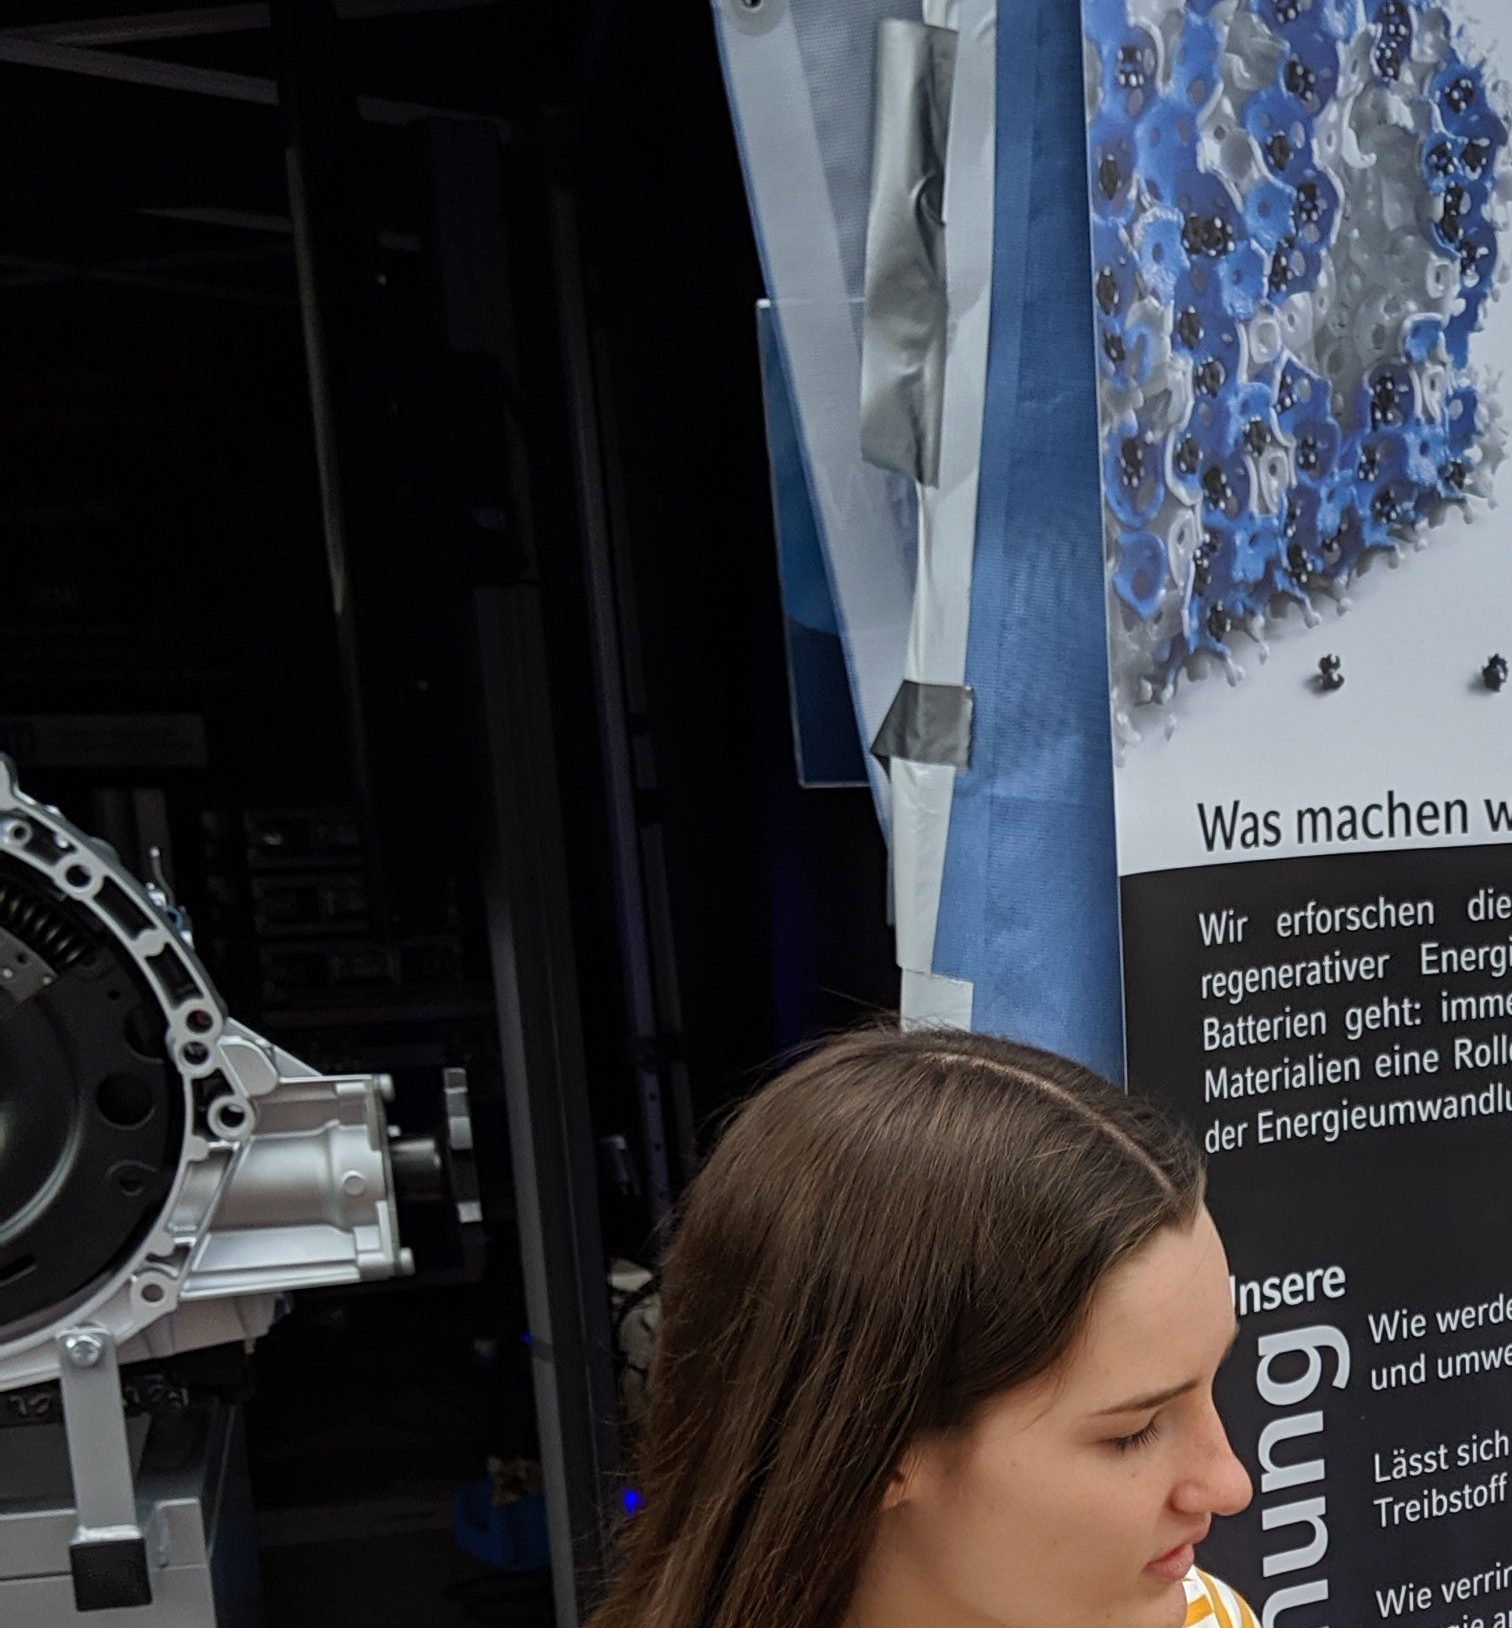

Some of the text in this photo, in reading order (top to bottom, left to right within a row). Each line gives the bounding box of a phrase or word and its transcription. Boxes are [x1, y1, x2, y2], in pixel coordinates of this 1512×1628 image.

[1197, 799, 1281, 851] Was
[1297, 790, 1467, 843] machen
[1198, 909, 1248, 945] Wir
[1277, 896, 1433, 936] erforschen
[1467, 888, 1511, 920] die
[1201, 950, 1389, 1004] regenerativer
[1203, 1006, 1325, 1050] Batterien
[1345, 996, 1420, 1040] geht:
[1205, 1052, 1359, 1102] Materialien
[1375, 1044, 1438, 1077] eine
[1205, 1120, 1248, 1153] der
[1368, 1308, 1426, 1343] Wie
[1371, 1353, 1425, 1390] und
[1374, 1444, 1448, 1482] Lässt
[1457, 1429, 1508, 1466] sich
[1373, 1471, 1507, 1527] Treibstoff
[1375, 1582, 1431, 1617] Wie
